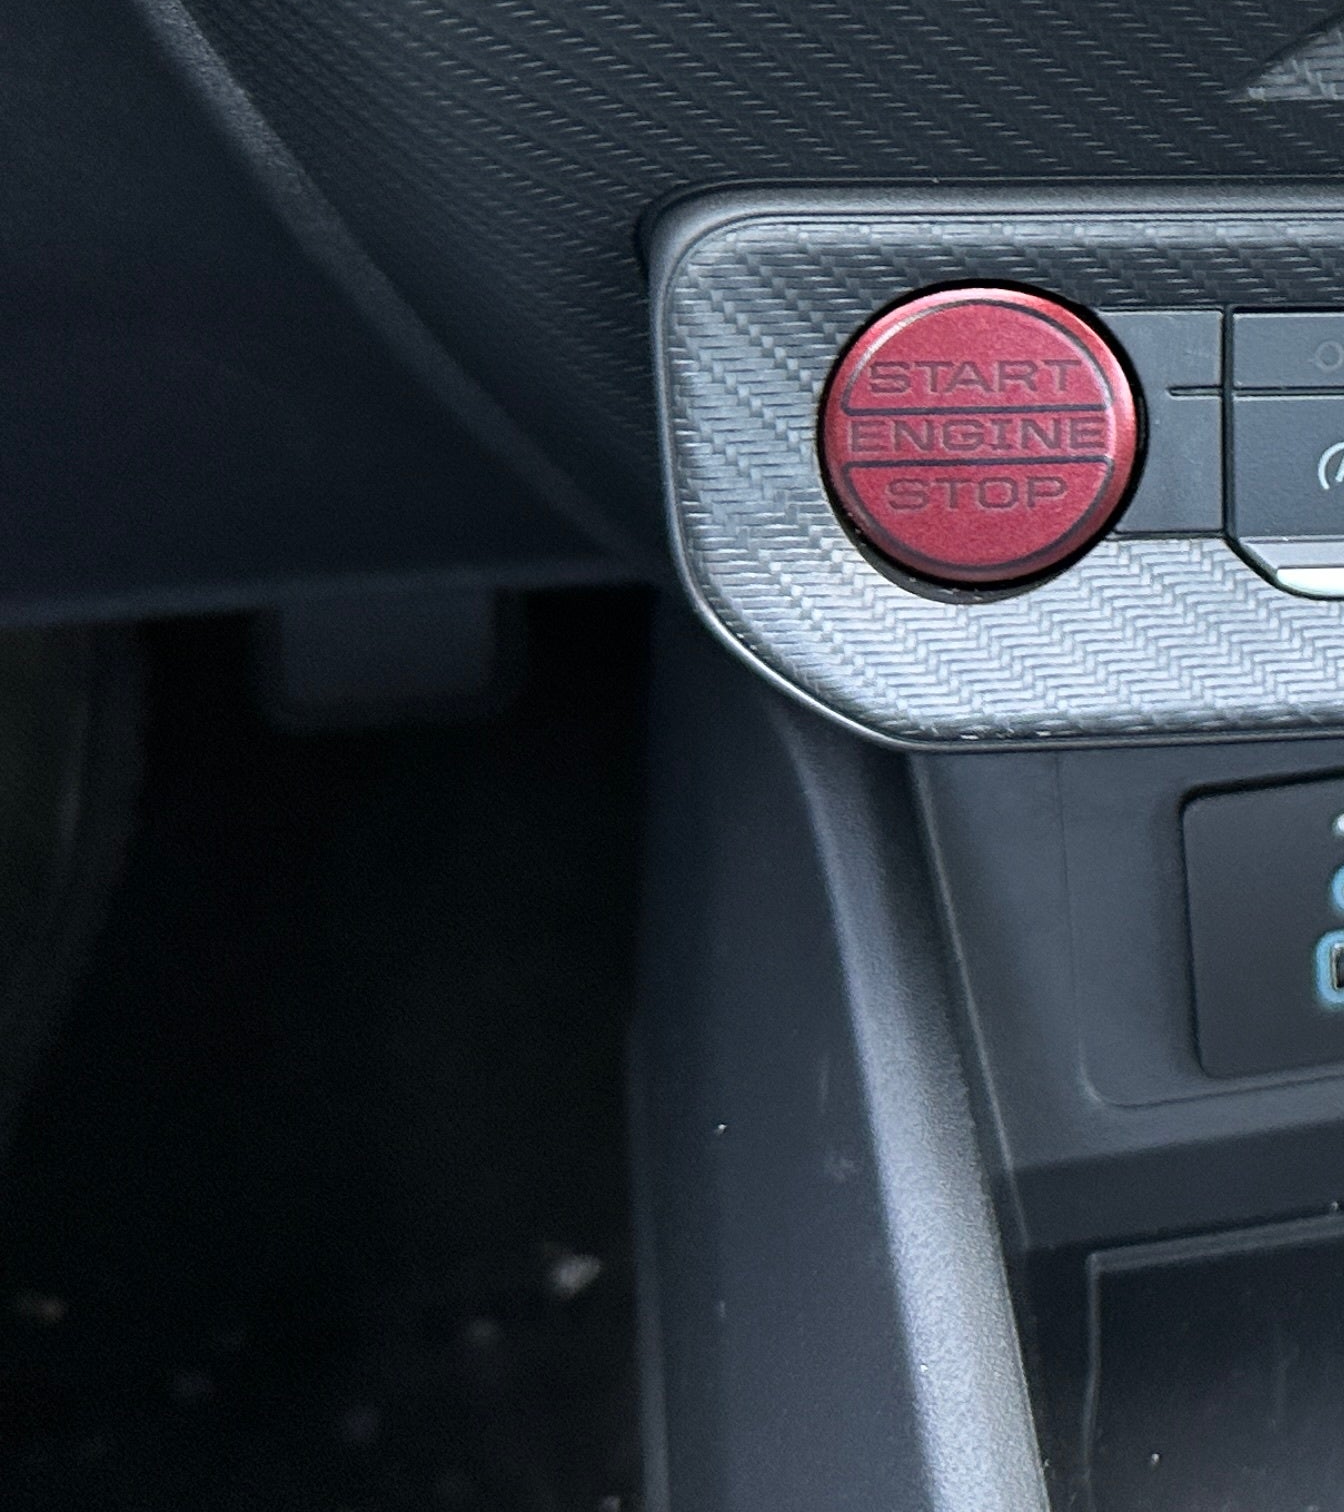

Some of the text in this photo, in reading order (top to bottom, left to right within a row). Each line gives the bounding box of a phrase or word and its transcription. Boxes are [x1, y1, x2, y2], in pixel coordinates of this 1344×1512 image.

[867, 359, 1083, 395] START
[849, 417, 1107, 454] ENGINE
[886, 476, 1067, 511] STOP
